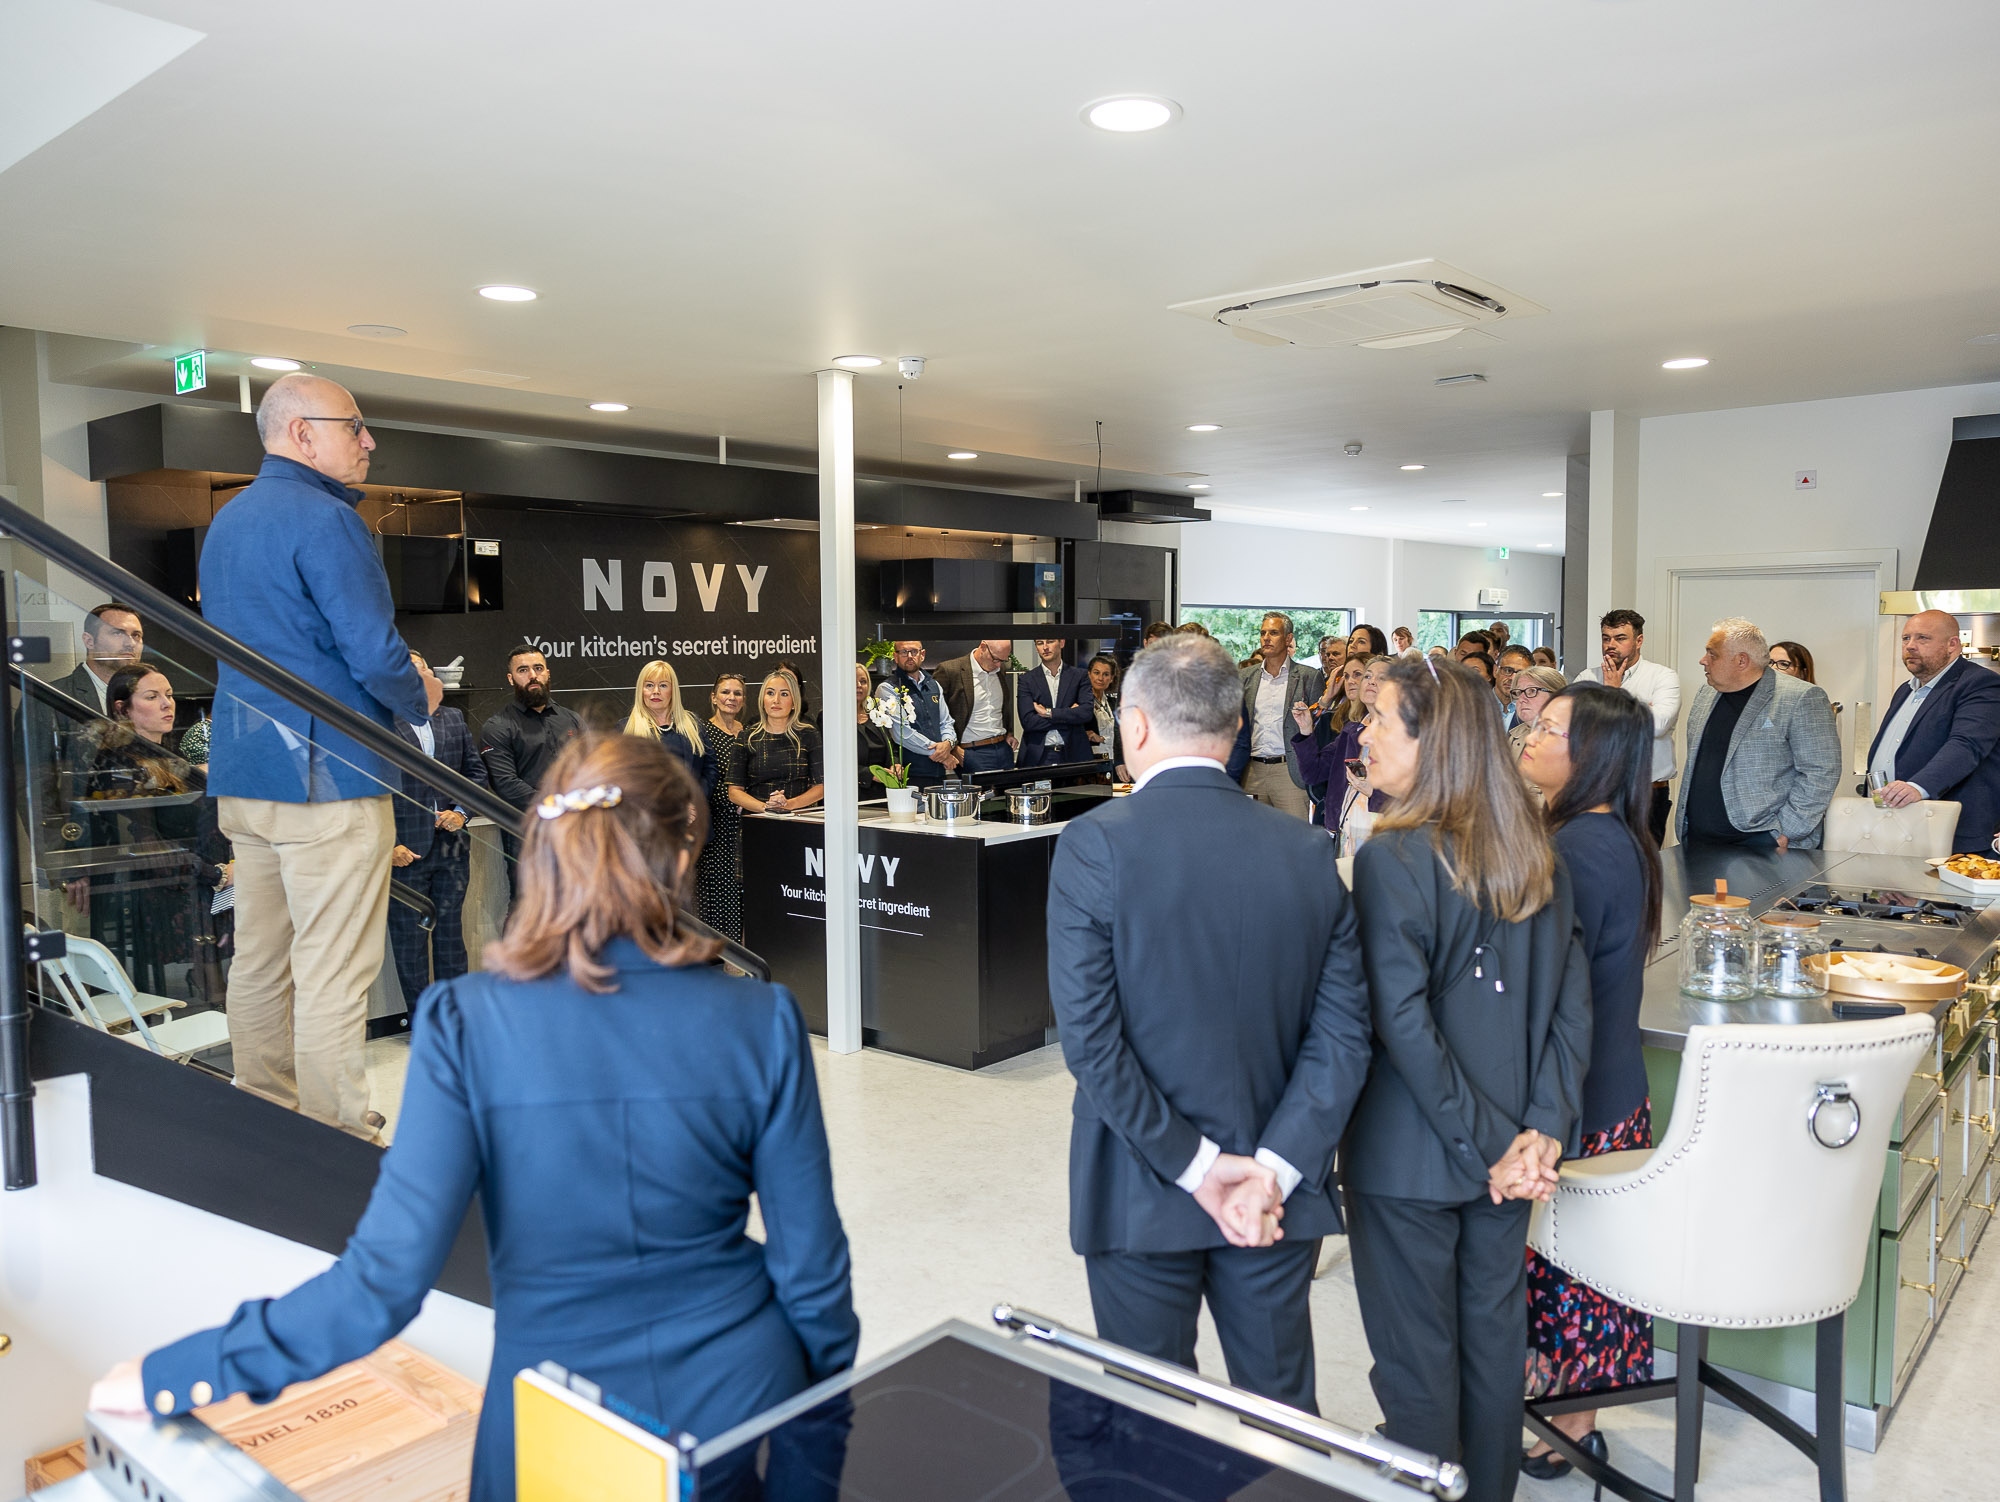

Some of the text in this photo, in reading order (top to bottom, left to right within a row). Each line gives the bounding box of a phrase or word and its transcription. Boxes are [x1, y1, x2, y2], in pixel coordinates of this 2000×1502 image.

[582, 558, 769, 613] NOVY
[523, 635, 817, 660] Your kitchen's secret ingredient
[804, 847, 900, 887] NVY
[780, 884, 931, 918] Your kitch cret ingredient
[304, 1398, 358, 1424] 1830
